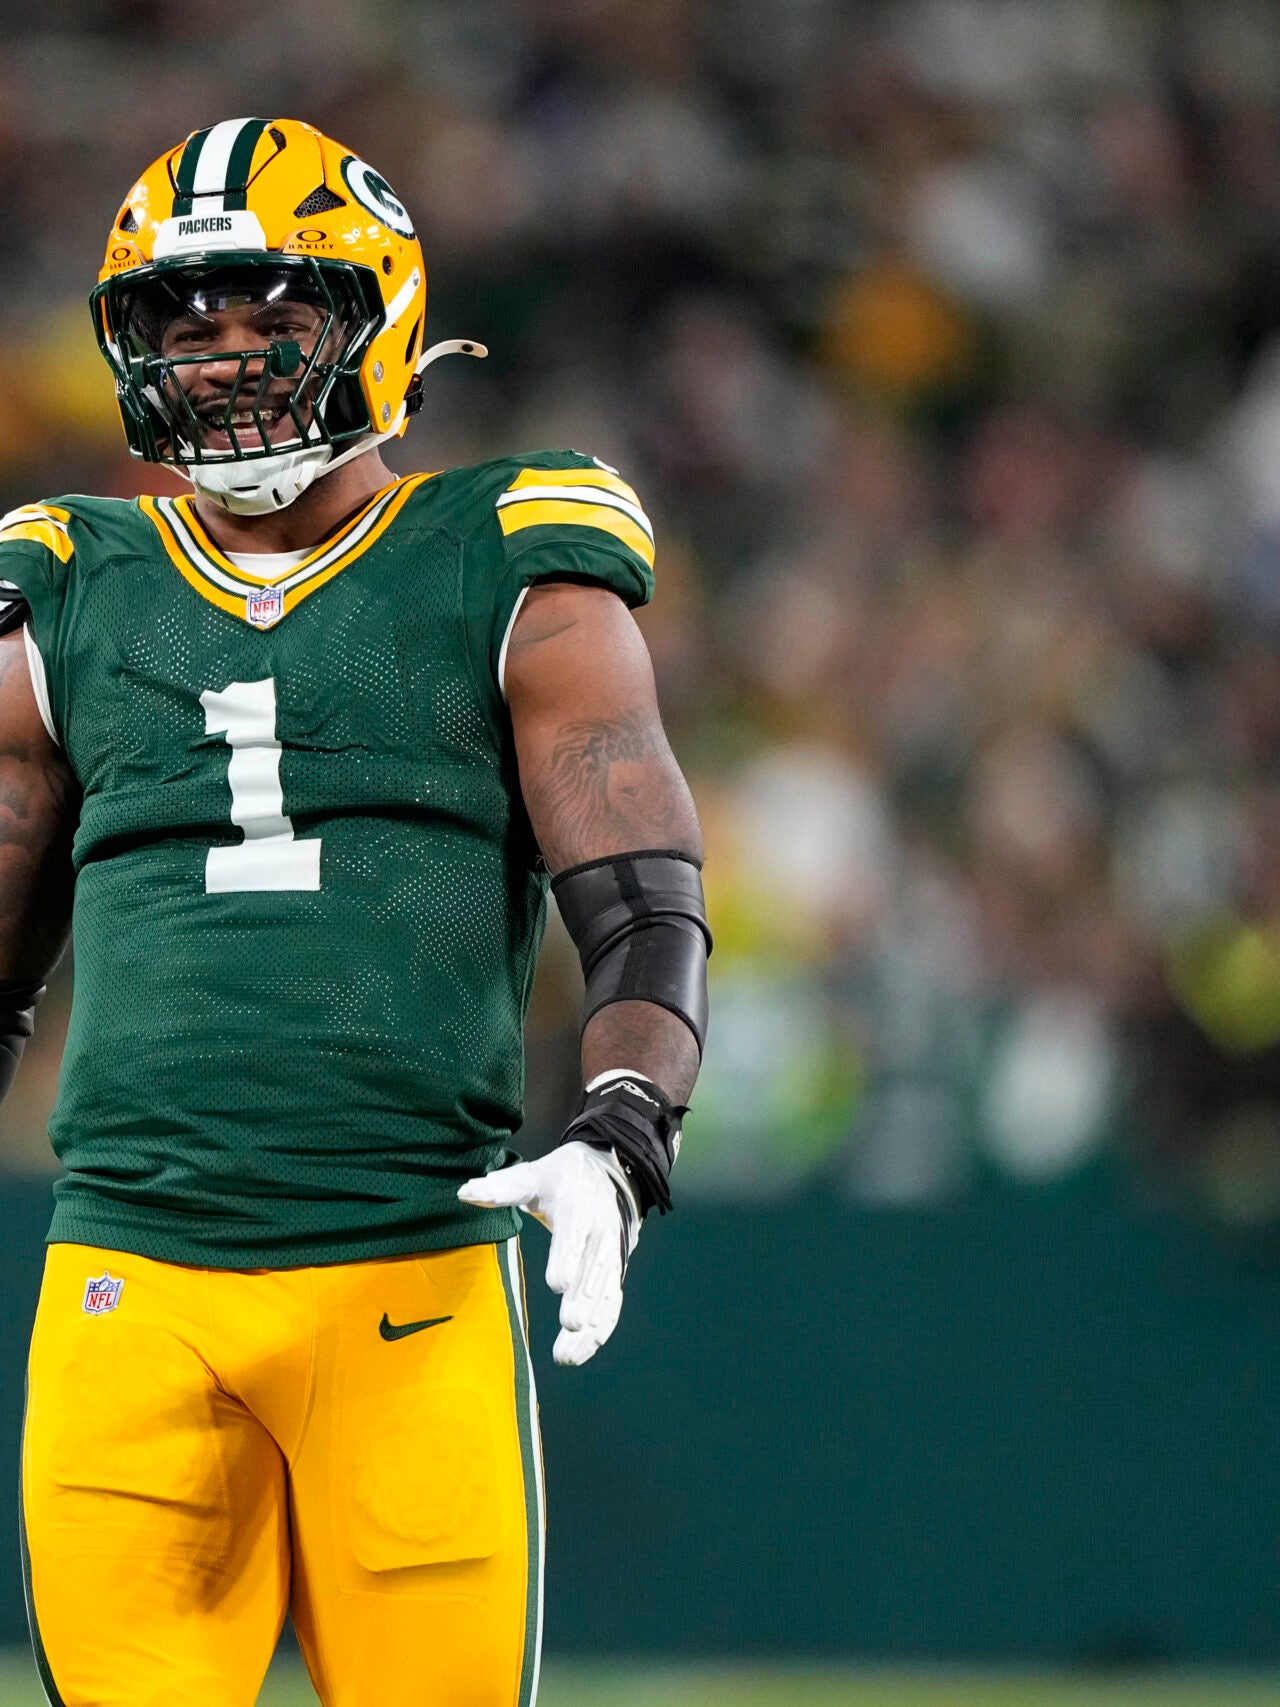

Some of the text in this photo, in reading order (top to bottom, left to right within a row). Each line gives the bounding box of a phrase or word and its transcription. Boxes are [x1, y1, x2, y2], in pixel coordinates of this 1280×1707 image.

[178, 216, 233, 236] PACKERS
[253, 600, 278, 617] NFL
[198, 677, 322, 894] 1
[87, 1292, 113, 1310] NFL
